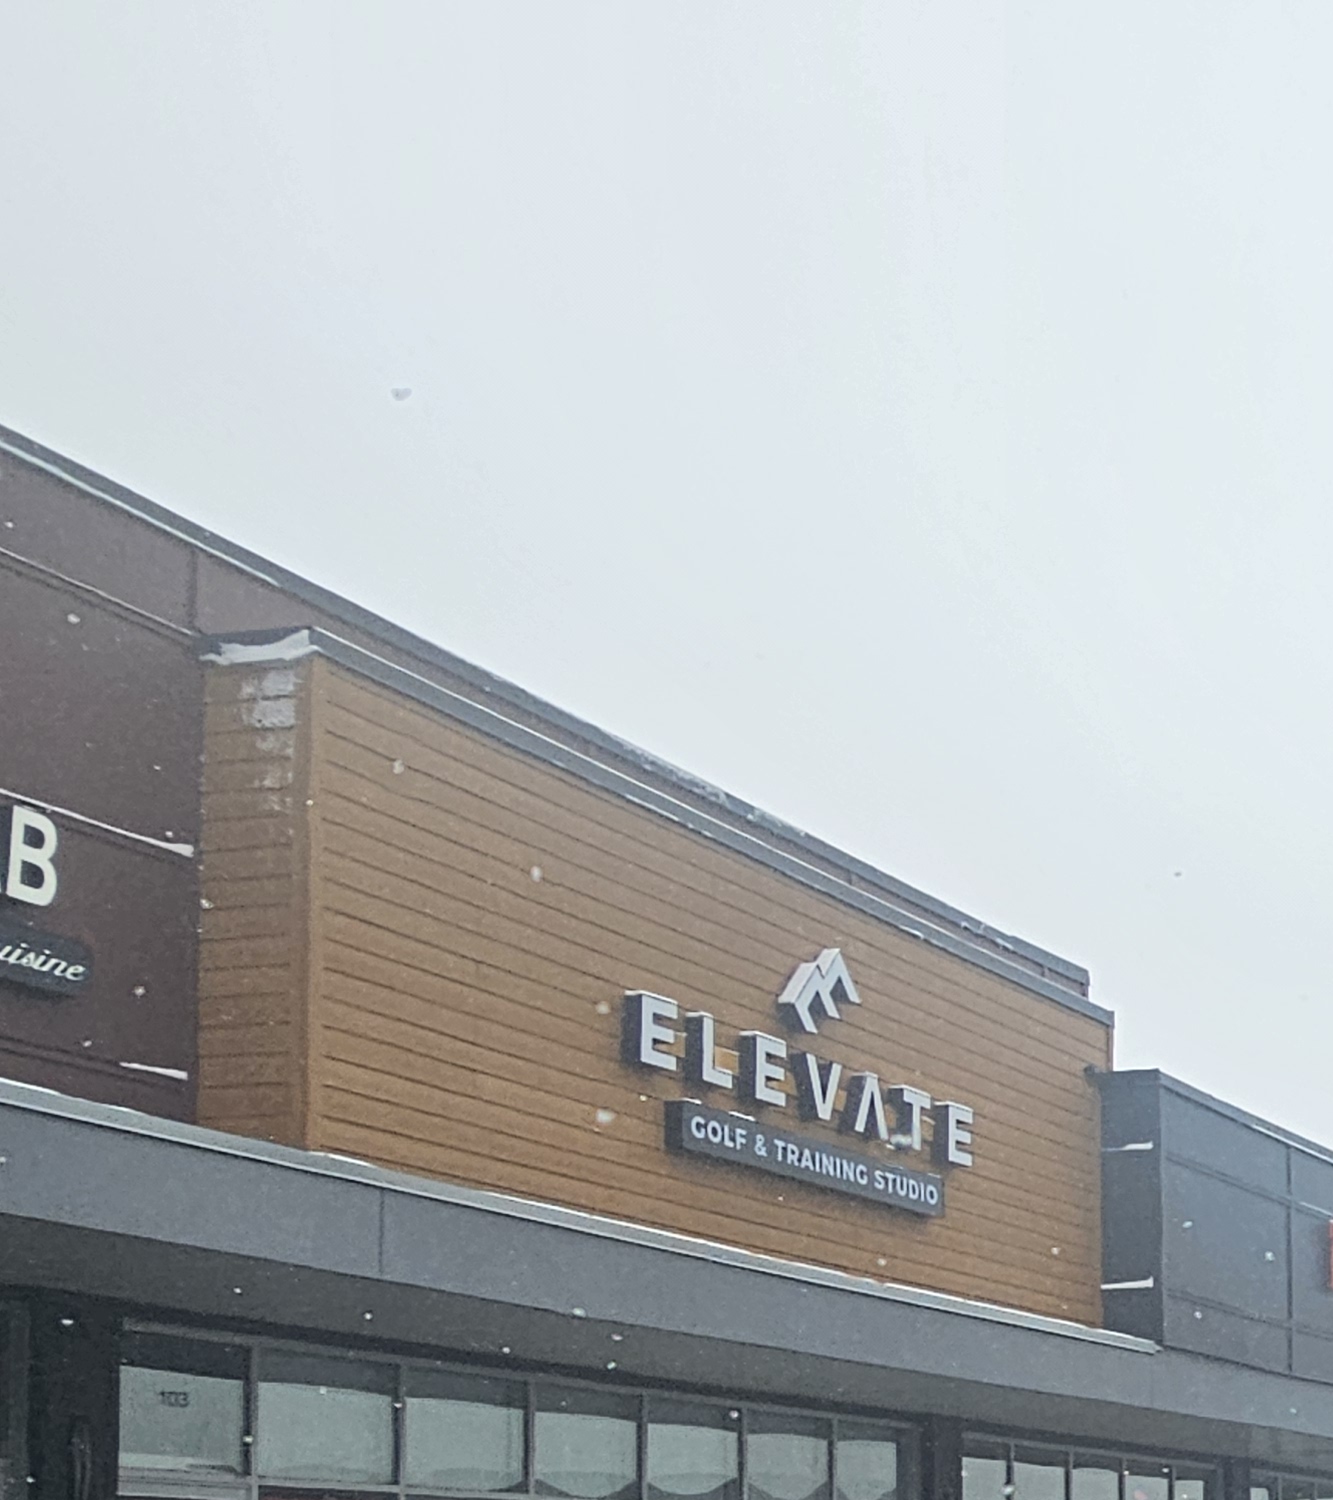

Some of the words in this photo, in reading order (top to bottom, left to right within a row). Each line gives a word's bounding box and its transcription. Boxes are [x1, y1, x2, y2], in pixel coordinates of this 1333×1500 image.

[636, 991, 974, 1167] ELEVATE
[690, 1115, 748, 1152] GOLF
[754, 1134, 768, 1157] &
[773, 1139, 869, 1186] TRAINING
[873, 1170, 940, 1206] STUDIO
